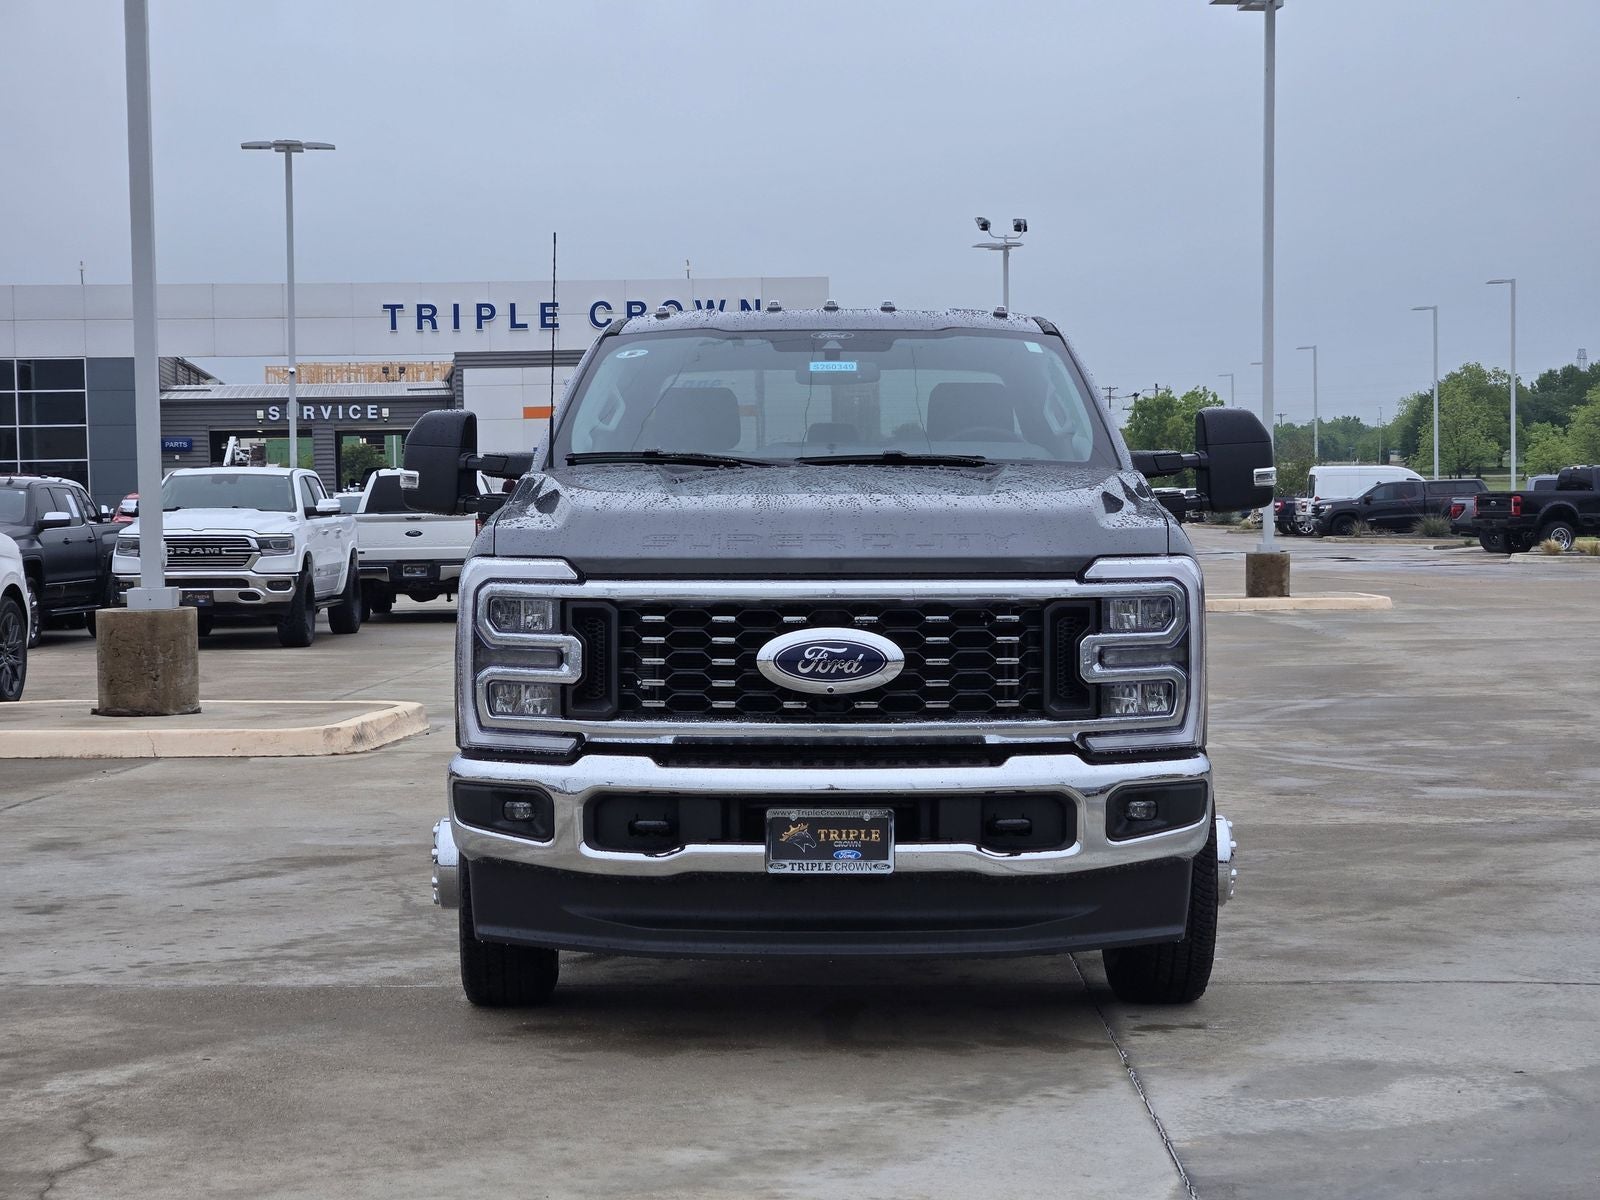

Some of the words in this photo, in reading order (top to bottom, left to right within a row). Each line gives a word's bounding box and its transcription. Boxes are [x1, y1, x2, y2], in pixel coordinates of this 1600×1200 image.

[382, 302, 560, 332] TRIPLE
[267, 404, 379, 421] SRVICE
[797, 646, 865, 674] Ford
[817, 829, 881, 842] TRIPLE
[788, 862, 832, 871] TRIPLE
[834, 862, 873, 871] CROWN
